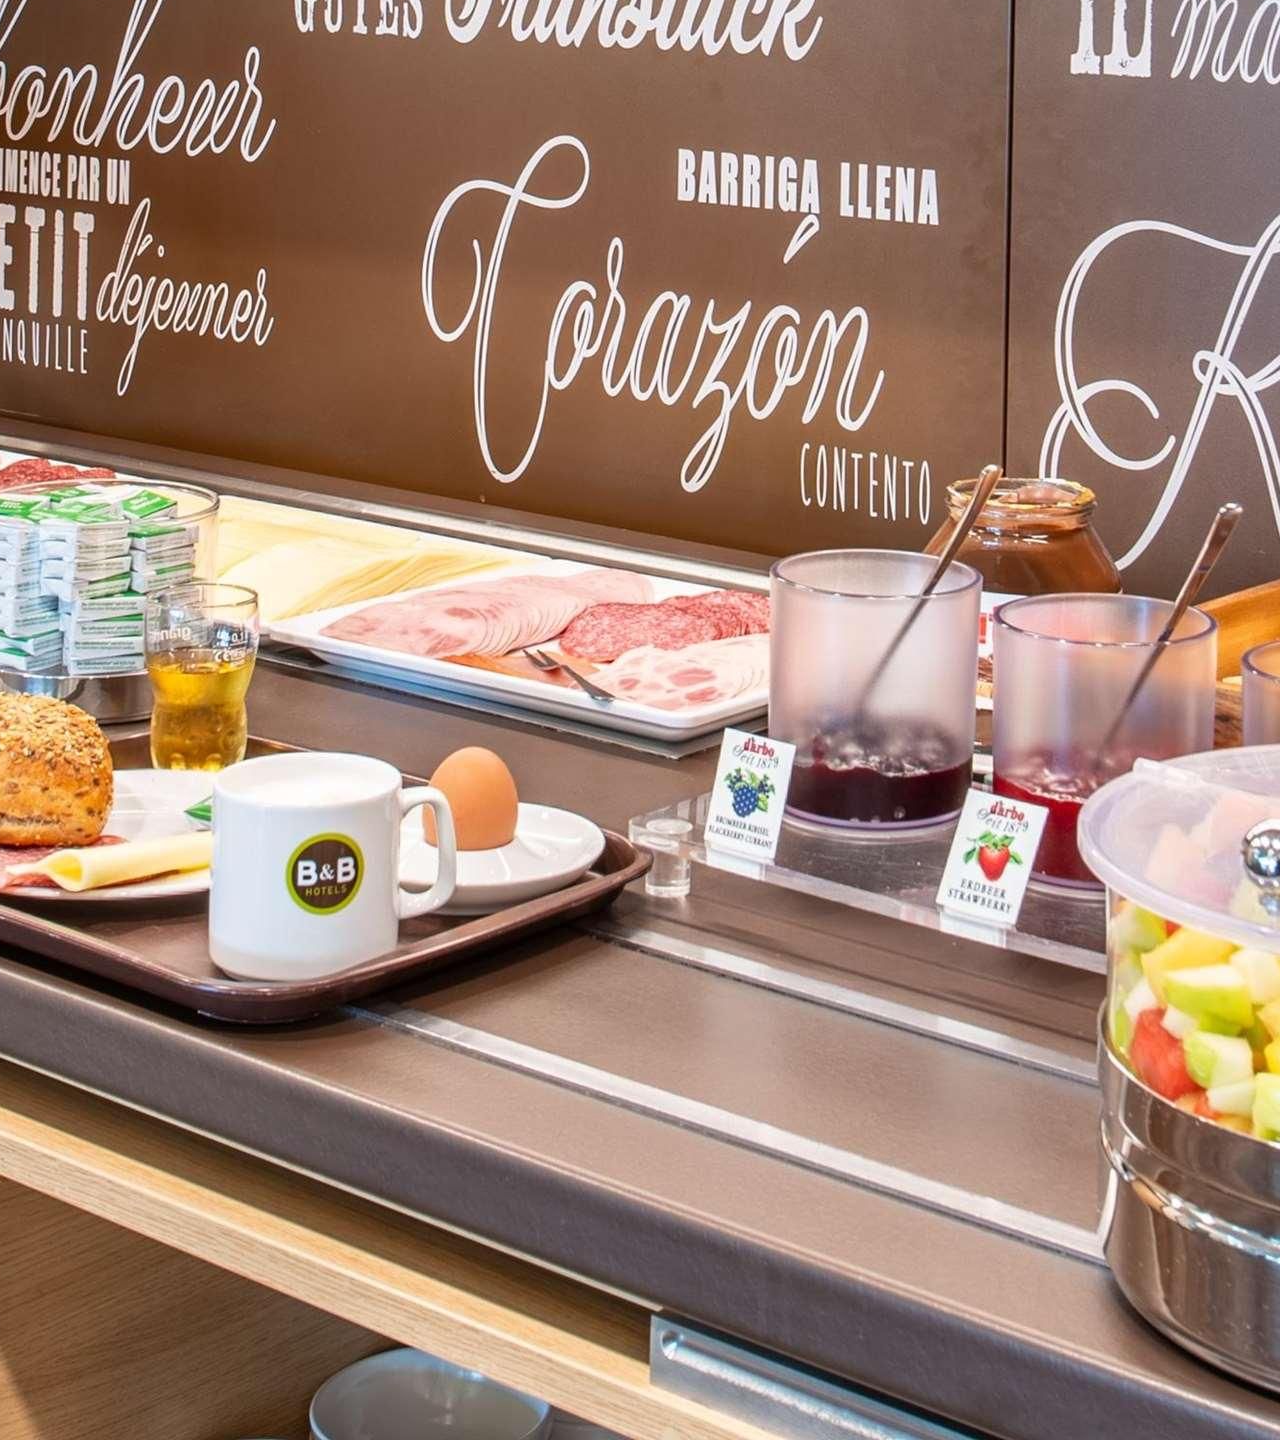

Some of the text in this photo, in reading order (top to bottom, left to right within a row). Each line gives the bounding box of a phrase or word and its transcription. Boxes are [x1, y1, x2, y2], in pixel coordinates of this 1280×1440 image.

[66, 153, 101, 203] PAR
[106, 157, 131, 206] UN
[676, 146, 941, 227] BARRIGA LLENA
[95, 198, 275, 397] déjeuner
[421, 134, 886, 493] Corazón
[799, 441, 933, 526] CONTENTO
[732, 743, 756, 768] Seit
[976, 807, 1001, 830] Seit
[296, 855, 357, 887] B&B
[305, 885, 348, 897] HOTELS
[946, 887, 1012, 914] STRAWBERRY
[960, 878, 1007, 899] ERDBEER
